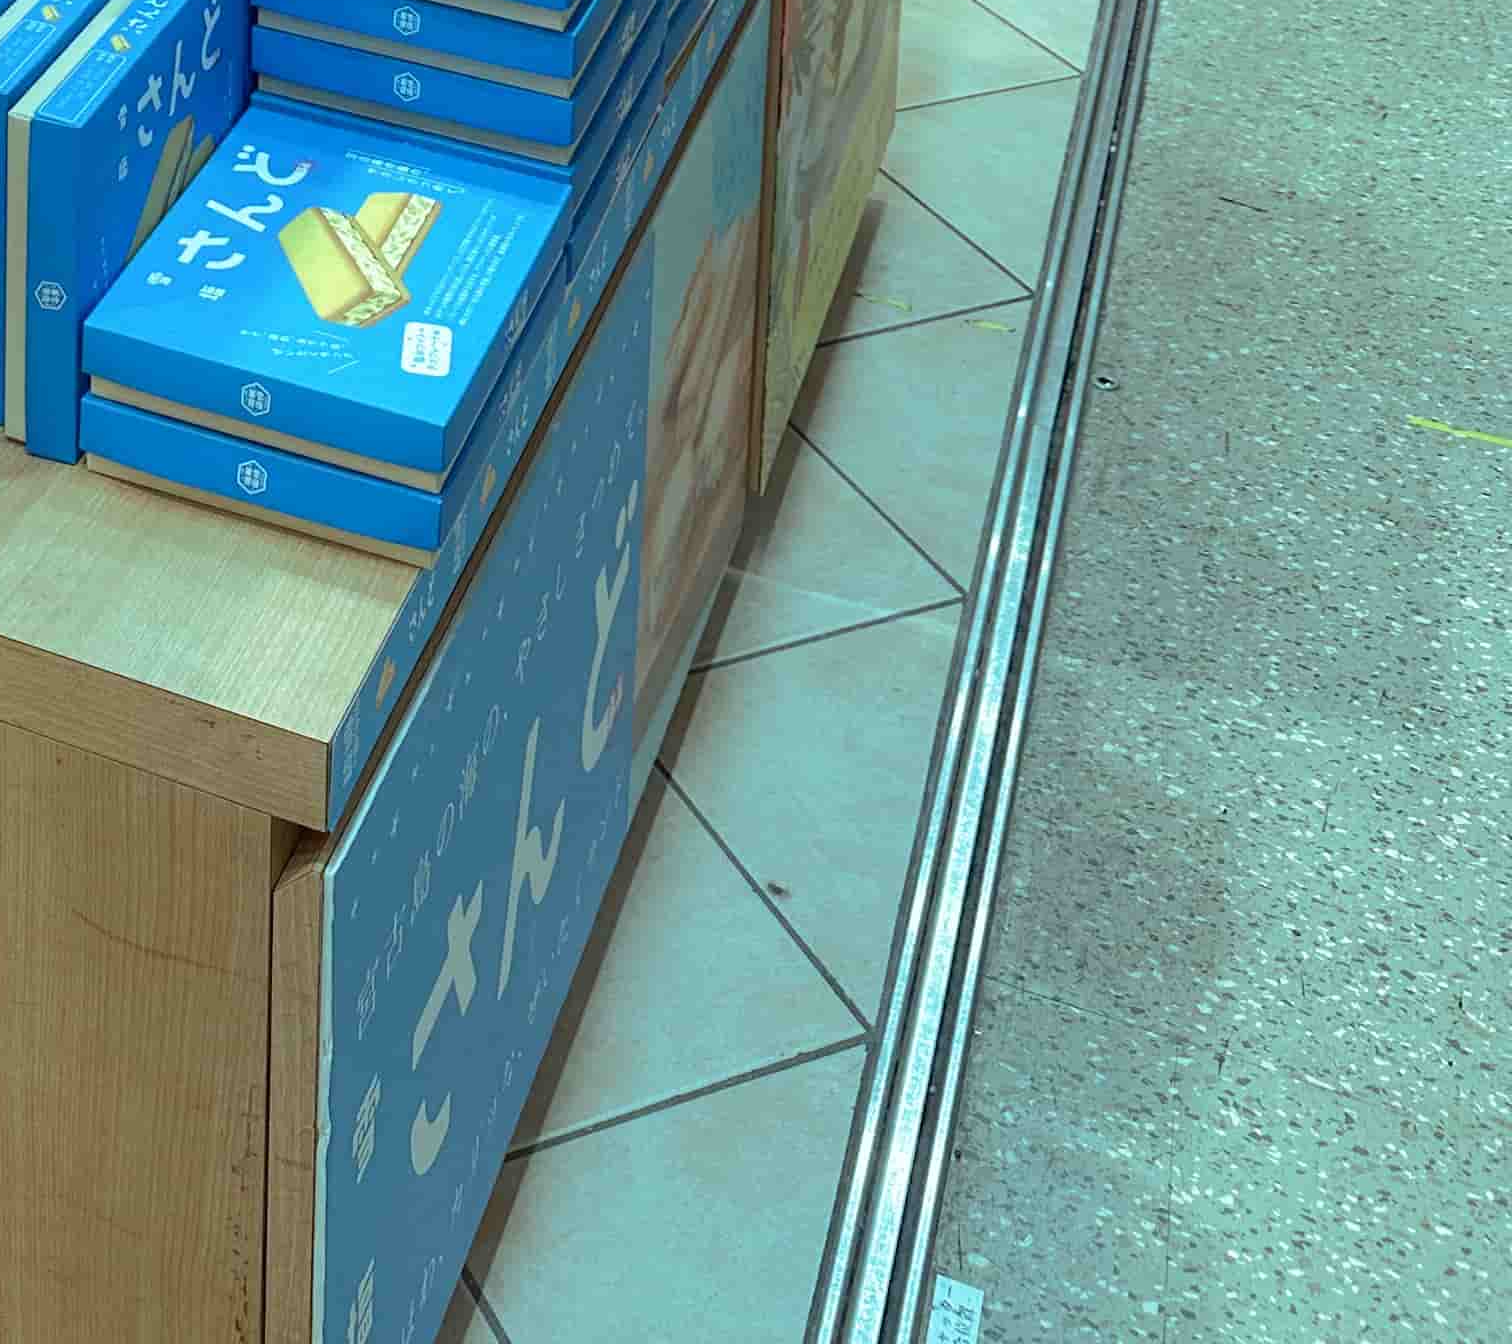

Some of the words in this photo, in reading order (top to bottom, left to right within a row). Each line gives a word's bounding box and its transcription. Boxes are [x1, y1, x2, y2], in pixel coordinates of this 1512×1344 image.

[176, 143, 314, 272] さんど
[409, 478, 640, 1176] さんど
